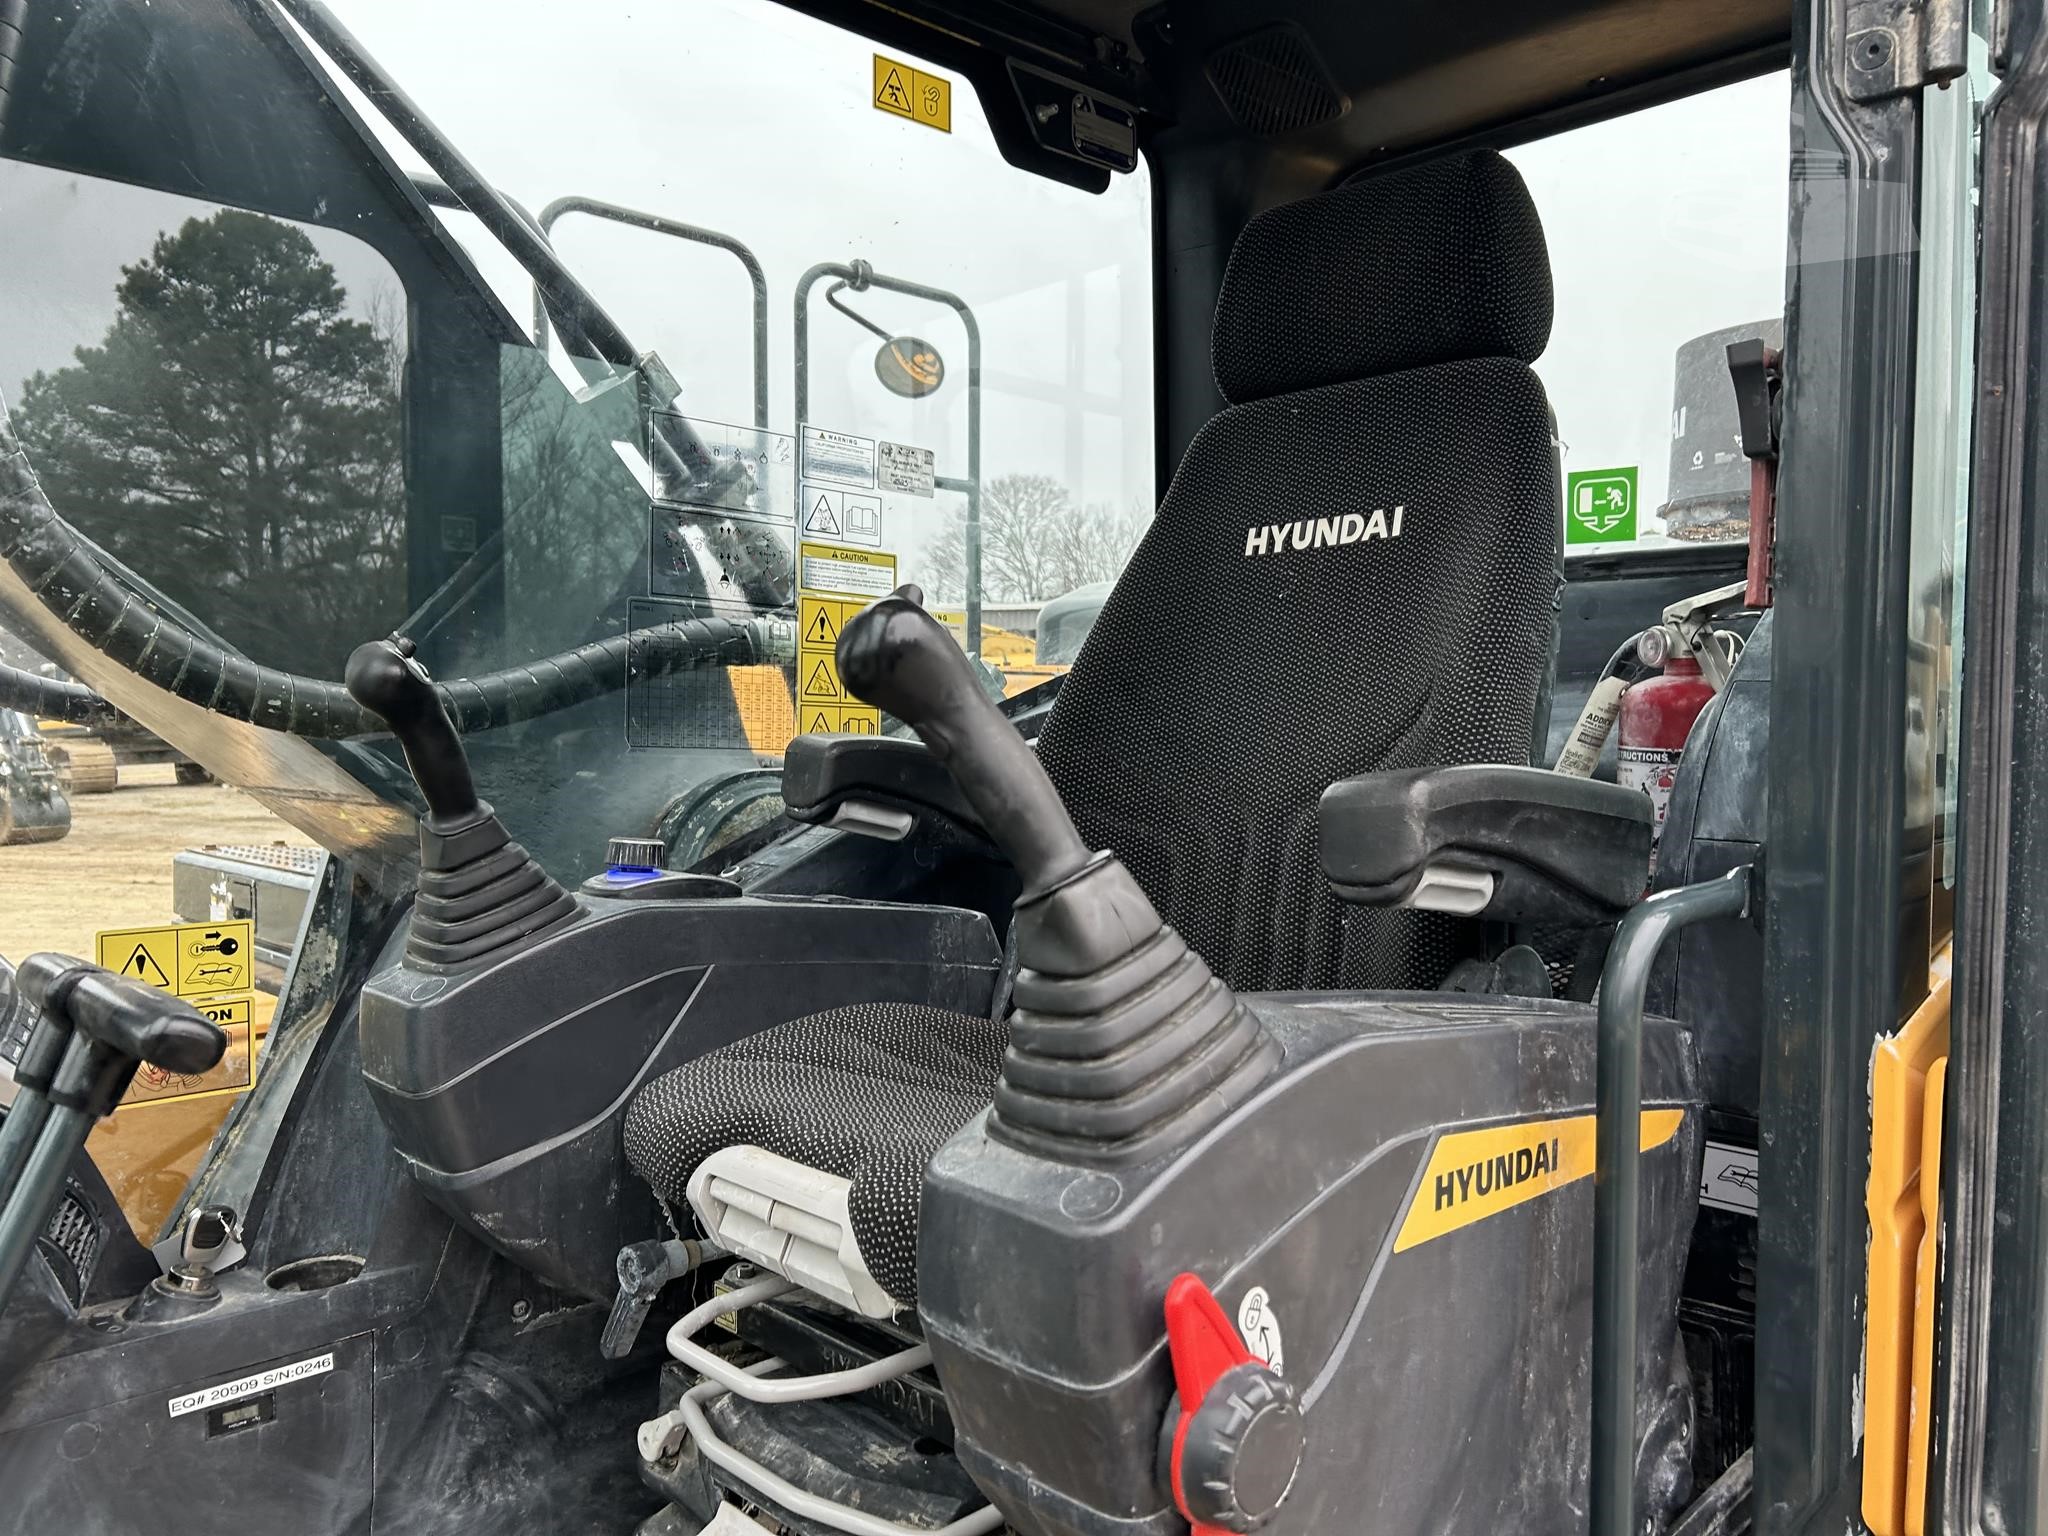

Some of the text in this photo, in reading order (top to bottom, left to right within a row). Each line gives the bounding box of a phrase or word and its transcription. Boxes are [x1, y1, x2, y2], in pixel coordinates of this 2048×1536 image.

[828, 434, 858, 445] WARNING
[1244, 505, 1404, 557] HYUNDAI
[840, 552, 869, 563] CAUTION
[1434, 1138, 1559, 1212] HYUNDAI
[171, 1357, 331, 1412] EQ# 20909 S/N:0246
